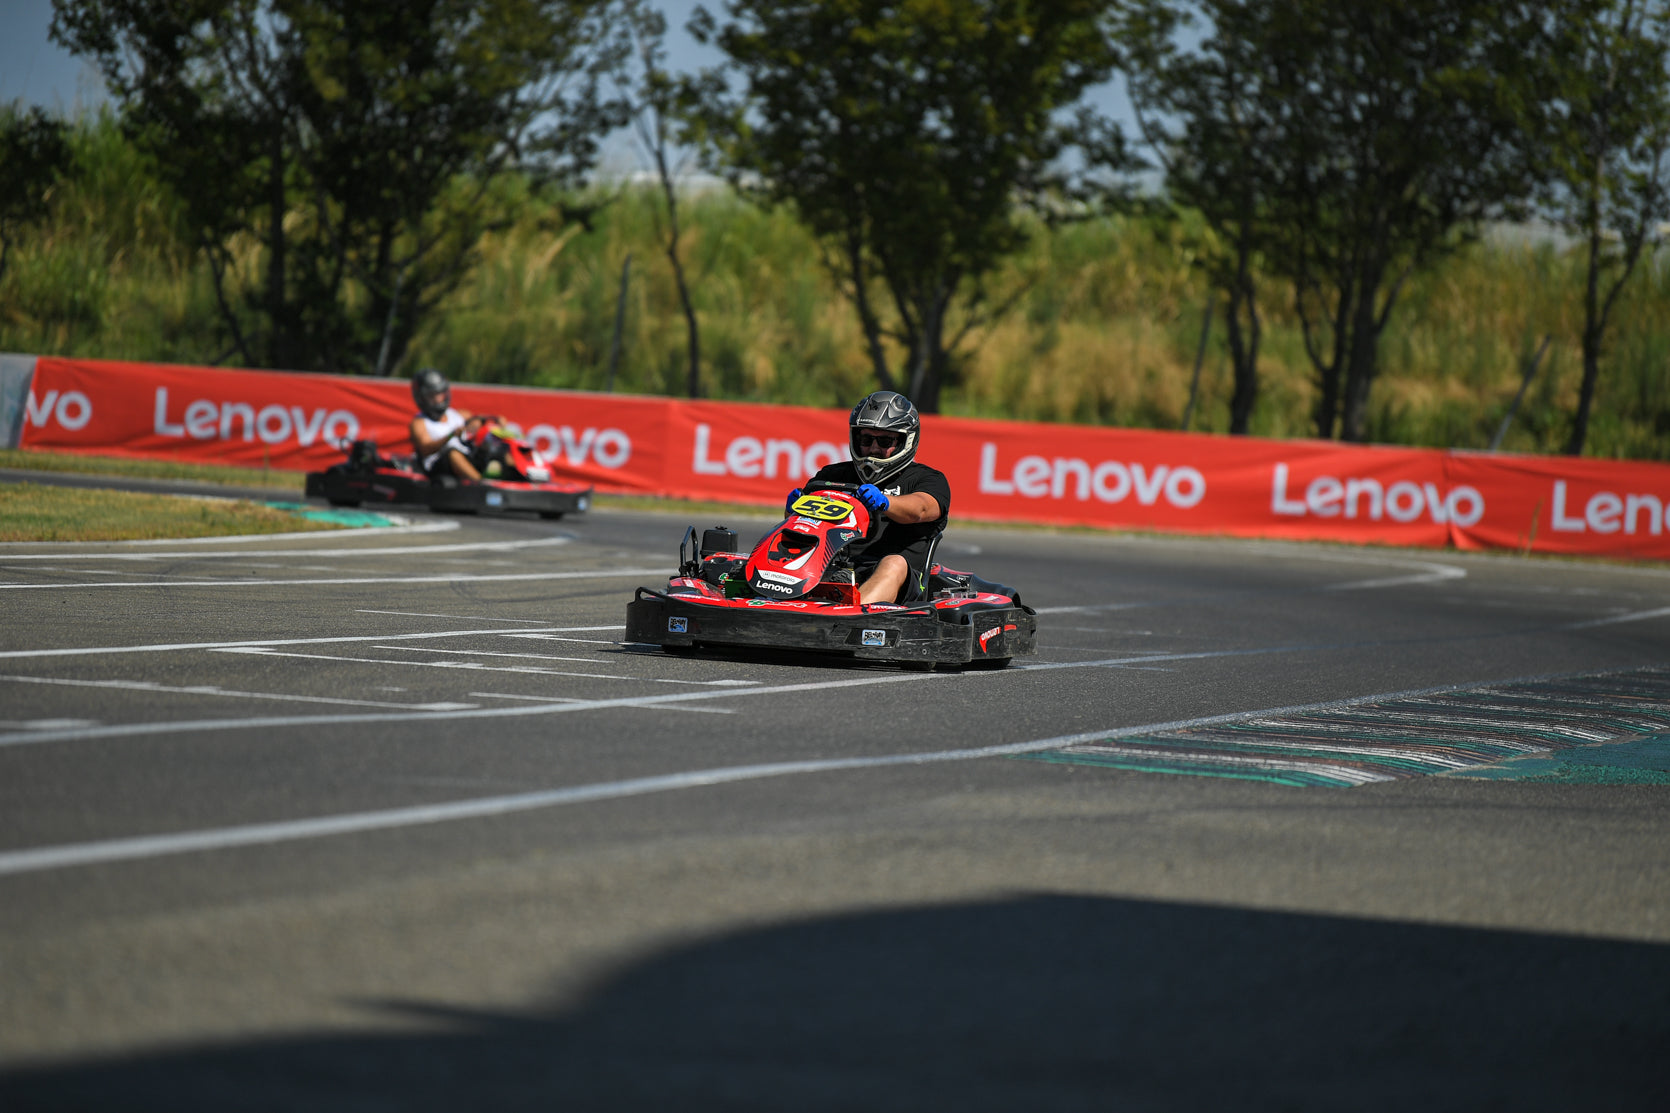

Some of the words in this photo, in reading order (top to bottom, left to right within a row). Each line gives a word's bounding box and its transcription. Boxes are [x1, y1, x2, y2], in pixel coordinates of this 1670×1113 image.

[154, 387, 360, 447] Lenovo
[693, 423, 851, 481] Leno
[979, 443, 1206, 508] Lenovo
[795, 499, 848, 517] 59
[1272, 463, 1485, 527] Lenovo
[1552, 479, 1670, 536] Len
[756, 580, 793, 594] Lenovo
